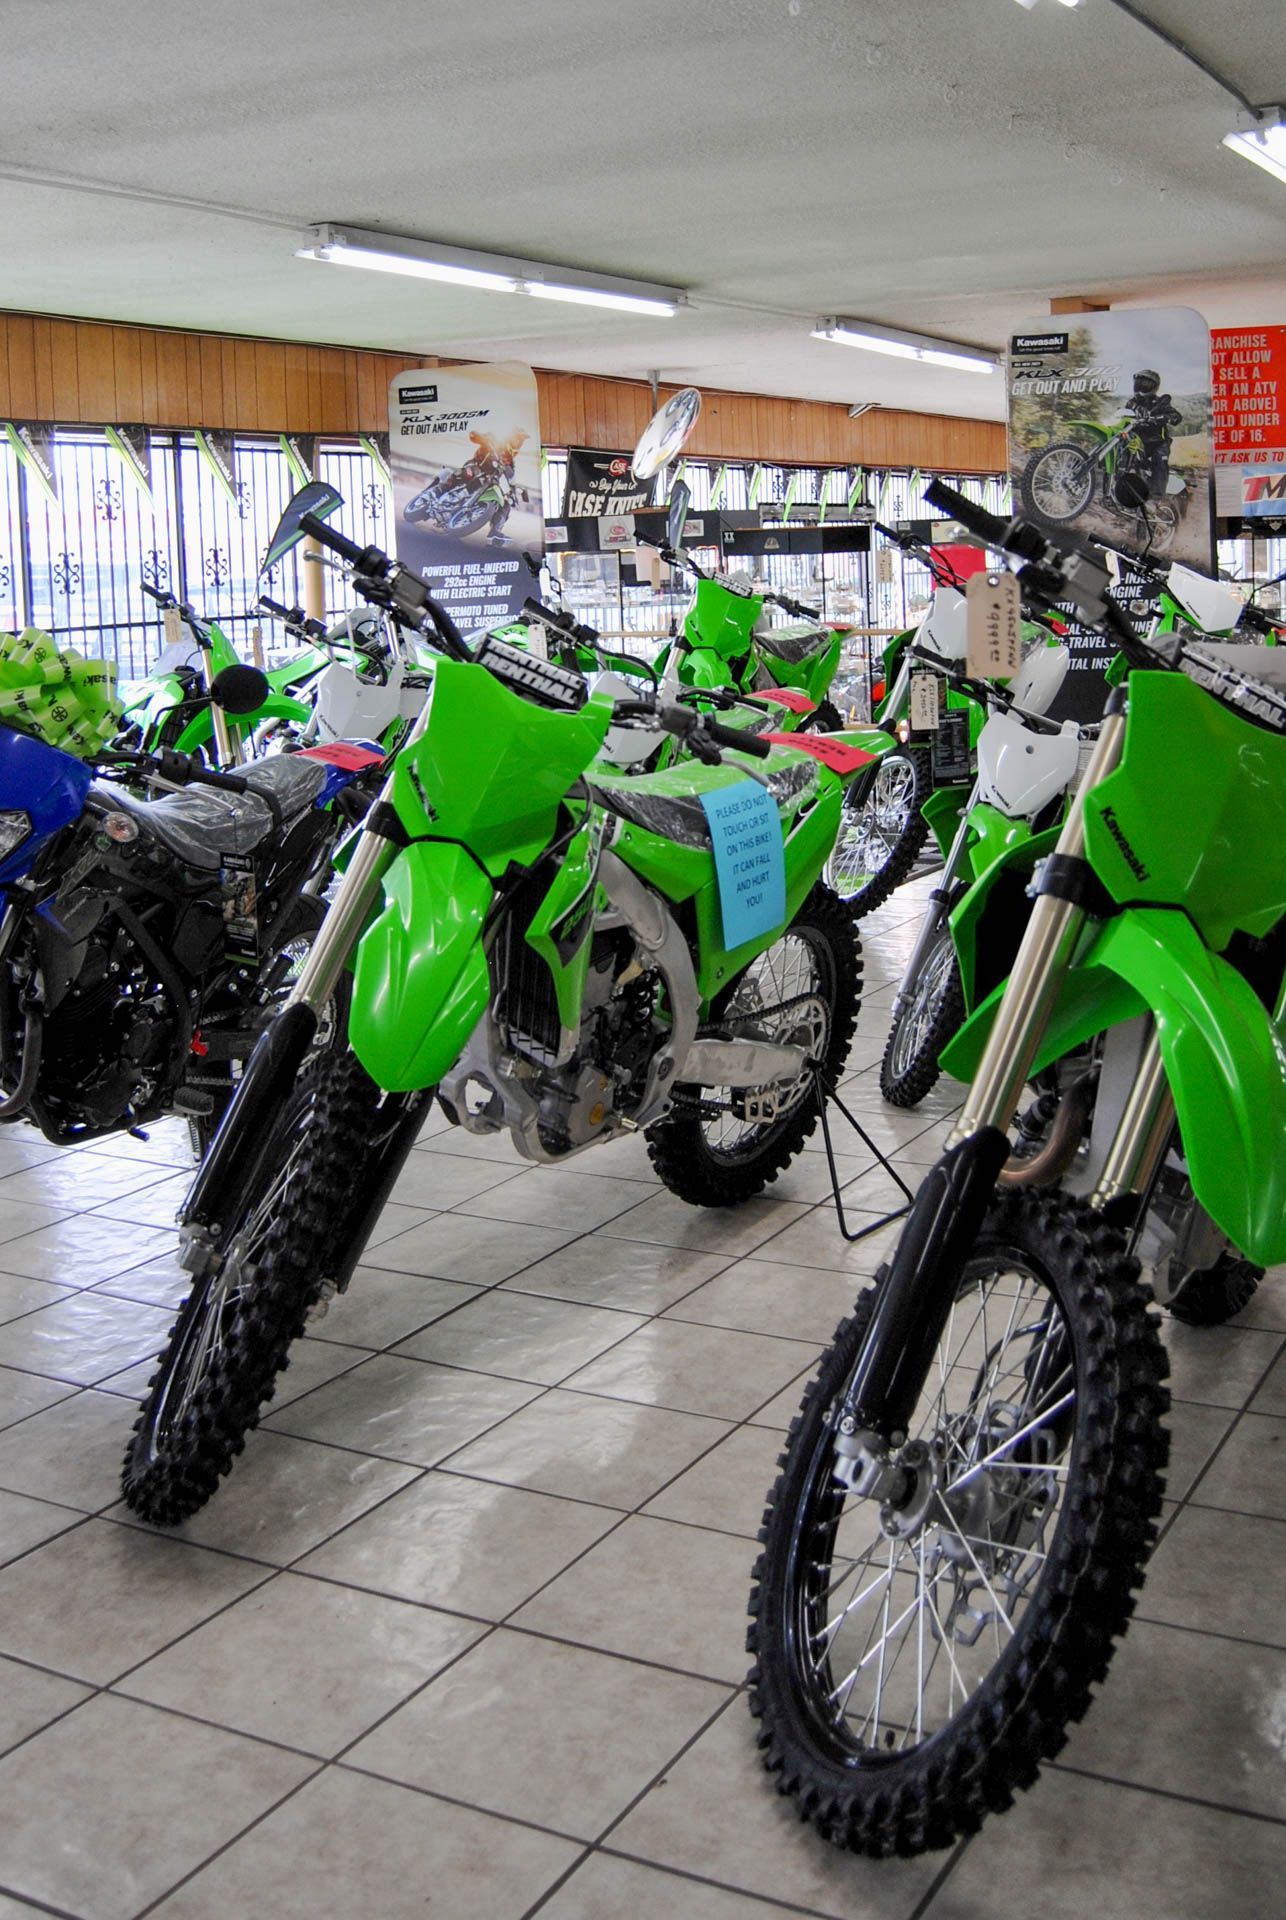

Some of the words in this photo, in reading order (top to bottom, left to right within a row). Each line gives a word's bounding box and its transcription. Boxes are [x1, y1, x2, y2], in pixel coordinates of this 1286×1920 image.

[1016, 336, 1064, 347] Kawasaki
[1212, 334, 1267, 349] ANCHISE
[1212, 352, 1227, 365] OT
[1232, 350, 1272, 365] ALLOW
[1015, 369, 1065, 379] KLX
[1068, 367, 1121, 377] 300
[1220, 367, 1247, 380] SELL
[1252, 366, 1261, 379] A
[1012, 381, 1034, 396] GET
[1035, 380, 1060, 395] OUT
[1061, 379, 1087, 394] AND
[1088, 378, 1121, 392] PLAY
[1212, 383, 1226, 397] ER
[1232, 382, 1249, 395] AN
[1254, 381, 1277, 395] ATV
[1233, 396, 1277, 411] ABOVE)
[402, 415, 434, 423] KLX
[436, 410, 490, 420] 300SM
[1213, 415, 1235, 428] ILD
[1240, 413, 1280, 427] UNDER
[401, 424, 414, 435] GET
[416, 424, 431, 434] OUT
[432, 422, 447, 433] AND
[449, 421, 469, 432] PLAY
[1231, 430, 1245, 442] OF
[1250, 429, 1266, 442] 16.
[1230, 453, 1250, 464] ASK
[1254, 451, 1268, 462] US
[1272, 451, 1284, 462] TO
[568, 490, 605, 518] CASE
[422, 565, 462, 577] POWERFUL
[463, 561, 519, 576] FUEL-INJECTED
[444, 577, 468, 588] 292cc
[469, 574, 497, 586] ENGINE
[430, 588, 449, 600] WITH
[450, 587, 486, 599] ELECTRIC
[487, 585, 512, 596] START
[444, 605, 481, 617] PERMOTO
[483, 604, 508, 615] TUNED
[1067, 658, 1089, 670] ITAL
[480, 651, 577, 705] RENTHAL
[1178, 657, 1285, 729] RENTHAL
[716, 801, 741, 819] PLEASE
[742, 799, 753, 812] DO
[753, 794, 768, 806] NOT
[722, 822, 748, 837] TOUCH
[749, 818, 759, 830] OR
[760, 812, 769, 825] SIT
[726, 845, 738, 856] ON
[739, 838, 755, 851] THIS
[755, 831, 772, 845] BIKE!
[1099, 805, 1152, 883] Kawasaki
[733, 864, 740, 875] IT
[740, 859, 755, 872] CAN
[755, 853, 771, 866] FALL
[736, 879, 751, 894] AND
[752, 871, 769, 887] HURT
[746, 892, 763, 908] YOU!
